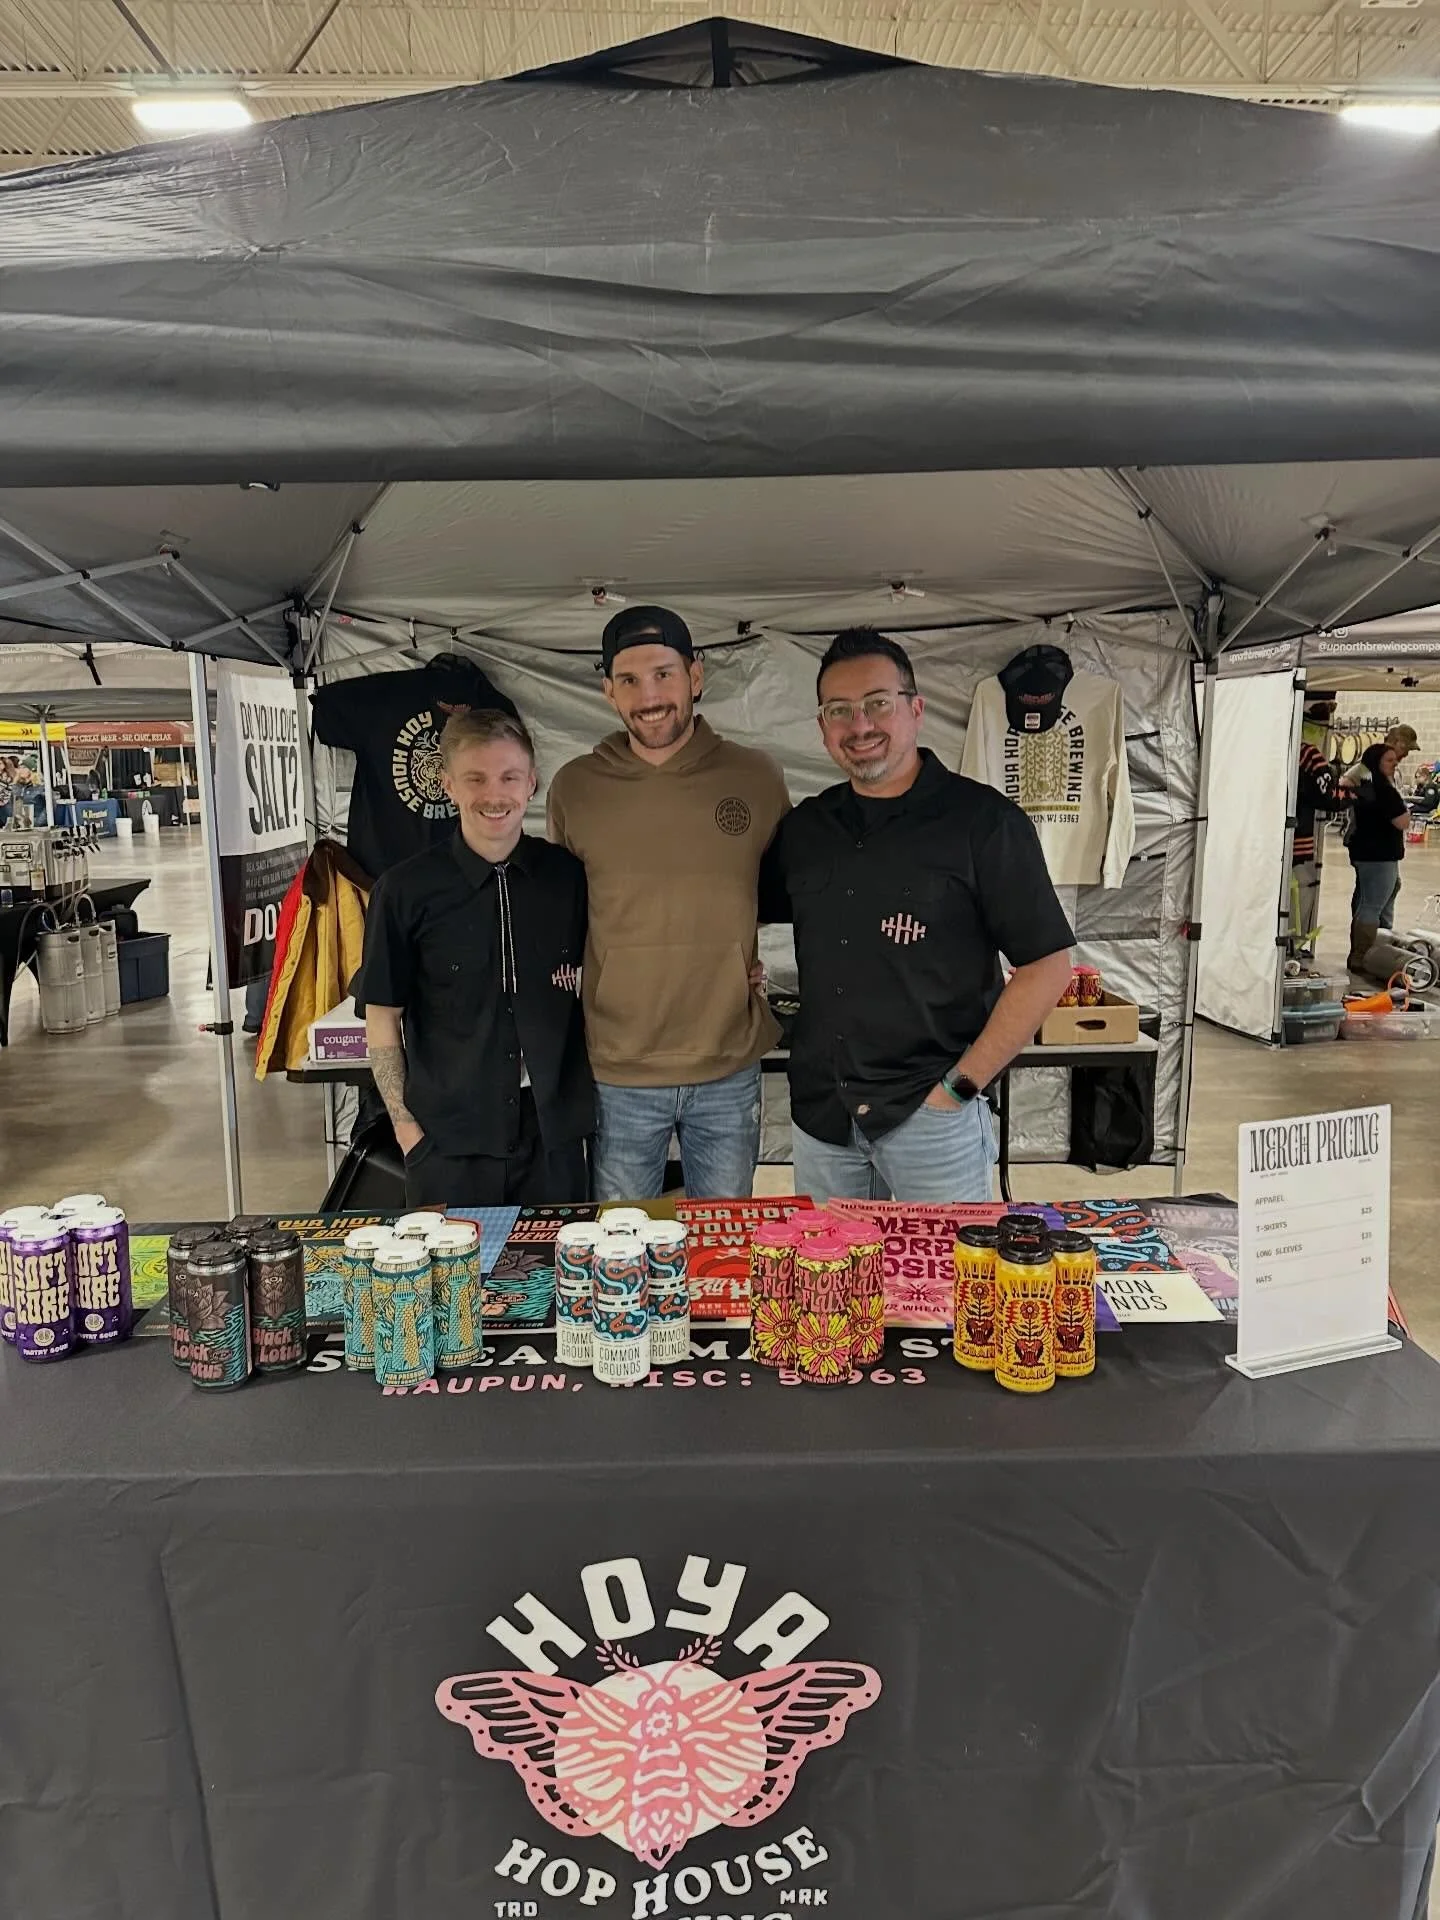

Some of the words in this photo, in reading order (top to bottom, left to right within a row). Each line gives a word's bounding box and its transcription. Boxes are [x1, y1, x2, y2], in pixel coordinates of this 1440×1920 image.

[240, 702, 254, 740] DO
[254, 704, 274, 741] YOU
[275, 707, 298, 742] LOVE
[397, 711, 433, 746] HOY
[1067, 725, 1085, 802] BREWING
[245, 743, 298, 835] SALT?
[392, 748, 423, 813] HOUSE
[423, 802, 459, 819] BRE
[243, 901, 282, 946] DO
[323, 1035, 361, 1047] cougar
[1249, 1123, 1311, 1173] MERCH
[1316, 1112, 1379, 1163] PRICING
[1255, 1194, 1285, 1205] APPAREL
[278, 1219, 325, 1230] OYA
[330, 1216, 381, 1229] HOP
[676, 1208, 731, 1221] OYA
[311, 1229, 350, 1238] BRE
[514, 1220, 564, 1231] HOP
[687, 1220, 776, 1234] HOUS
[872, 1215, 962, 1236] META
[1256, 1221, 1288, 1232] T-SHIRTS
[508, 1232, 557, 1240] REWI
[687, 1234, 746, 1247] REW
[884, 1236, 955, 1257] ORP
[1256, 1248, 1273, 1258] LONG
[1275, 1244, 1303, 1256] SLEEVES
[13, 1249, 67, 1292] SOFT
[758, 1256, 794, 1280] FLO
[800, 1268, 851, 1295] FLORA
[1100, 1279, 1154, 1294] MON
[1256, 1275, 1273, 1284] HATS
[75, 1271, 120, 1309] ORE
[16, 1282, 70, 1325] CORE
[902, 1304, 948, 1313] WHEAT
[1110, 1295, 1168, 1311] NDS
[252, 1327, 292, 1345] Black
[652, 1327, 686, 1341] OMMON
[561, 1344, 594, 1358] GROUN
[599, 1346, 640, 1361] COMMON
[651, 1341, 686, 1358] ROUNDS
[599, 1360, 641, 1376] GROUNDS
[610, 1369, 752, 1388] ISC:
[778, 1367, 926, 1387] 5963
[485, 1554, 830, 1677] HOYA
[494, 1838, 617, 1907] HOP
[631, 1826, 829, 1920] HOUSE
[780, 1889, 828, 1906] MRK
[494, 1901, 538, 1918] TRD
